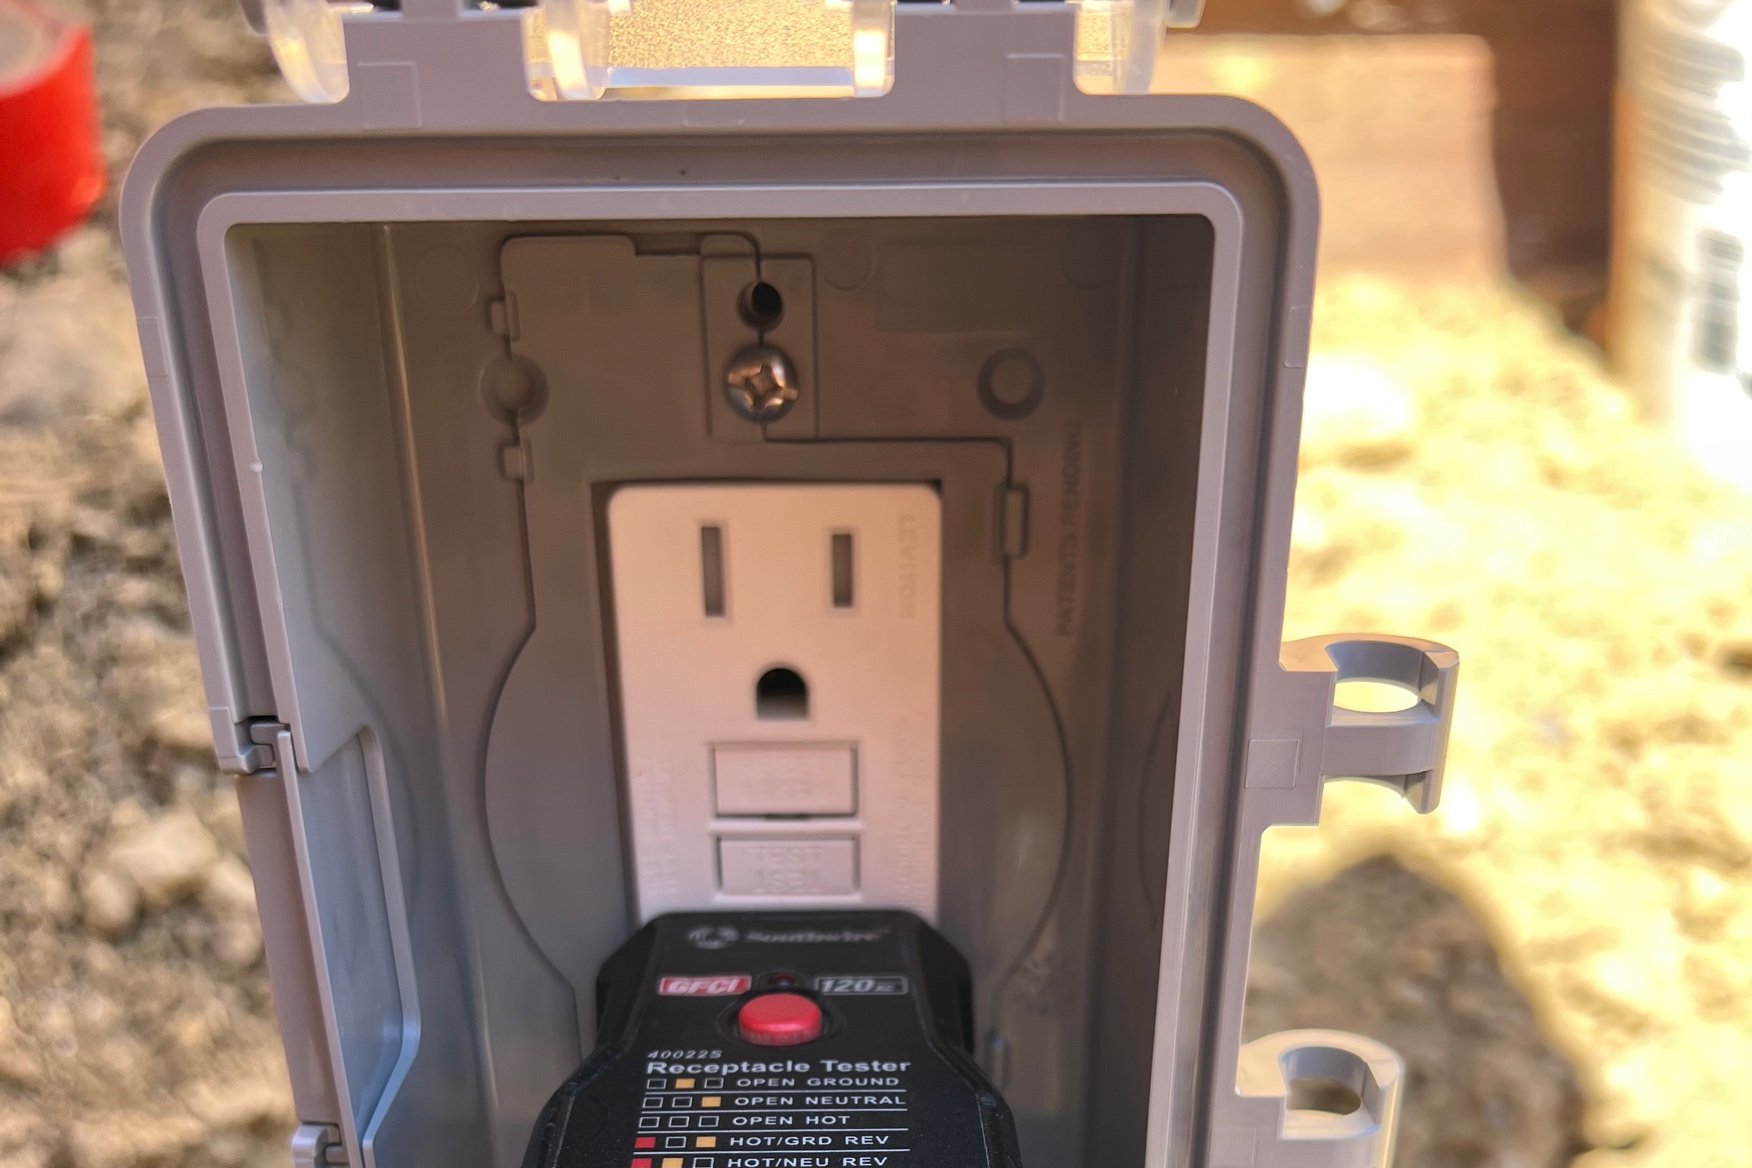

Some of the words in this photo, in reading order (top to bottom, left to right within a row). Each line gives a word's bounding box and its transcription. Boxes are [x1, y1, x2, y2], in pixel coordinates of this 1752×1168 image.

[668, 978, 739, 993] GFCI
[822, 979, 874, 993] 120
[646, 1061, 811, 1075] Receptacle
[819, 1060, 912, 1073] Tester
[737, 1078, 796, 1088] OPEN
[806, 1077, 900, 1087] GROUND
[734, 1096, 794, 1107] OPEN
[805, 1095, 907, 1105] NEUTRAL
[732, 1115, 794, 1126] OPEN
[805, 1115, 851, 1125] HOT
[729, 1135, 833, 1147] HOT/GRD
[845, 1135, 890, 1145] REV
[727, 1157, 830, 1168] HOT/NEU
[842, 1156, 888, 1167] REV
